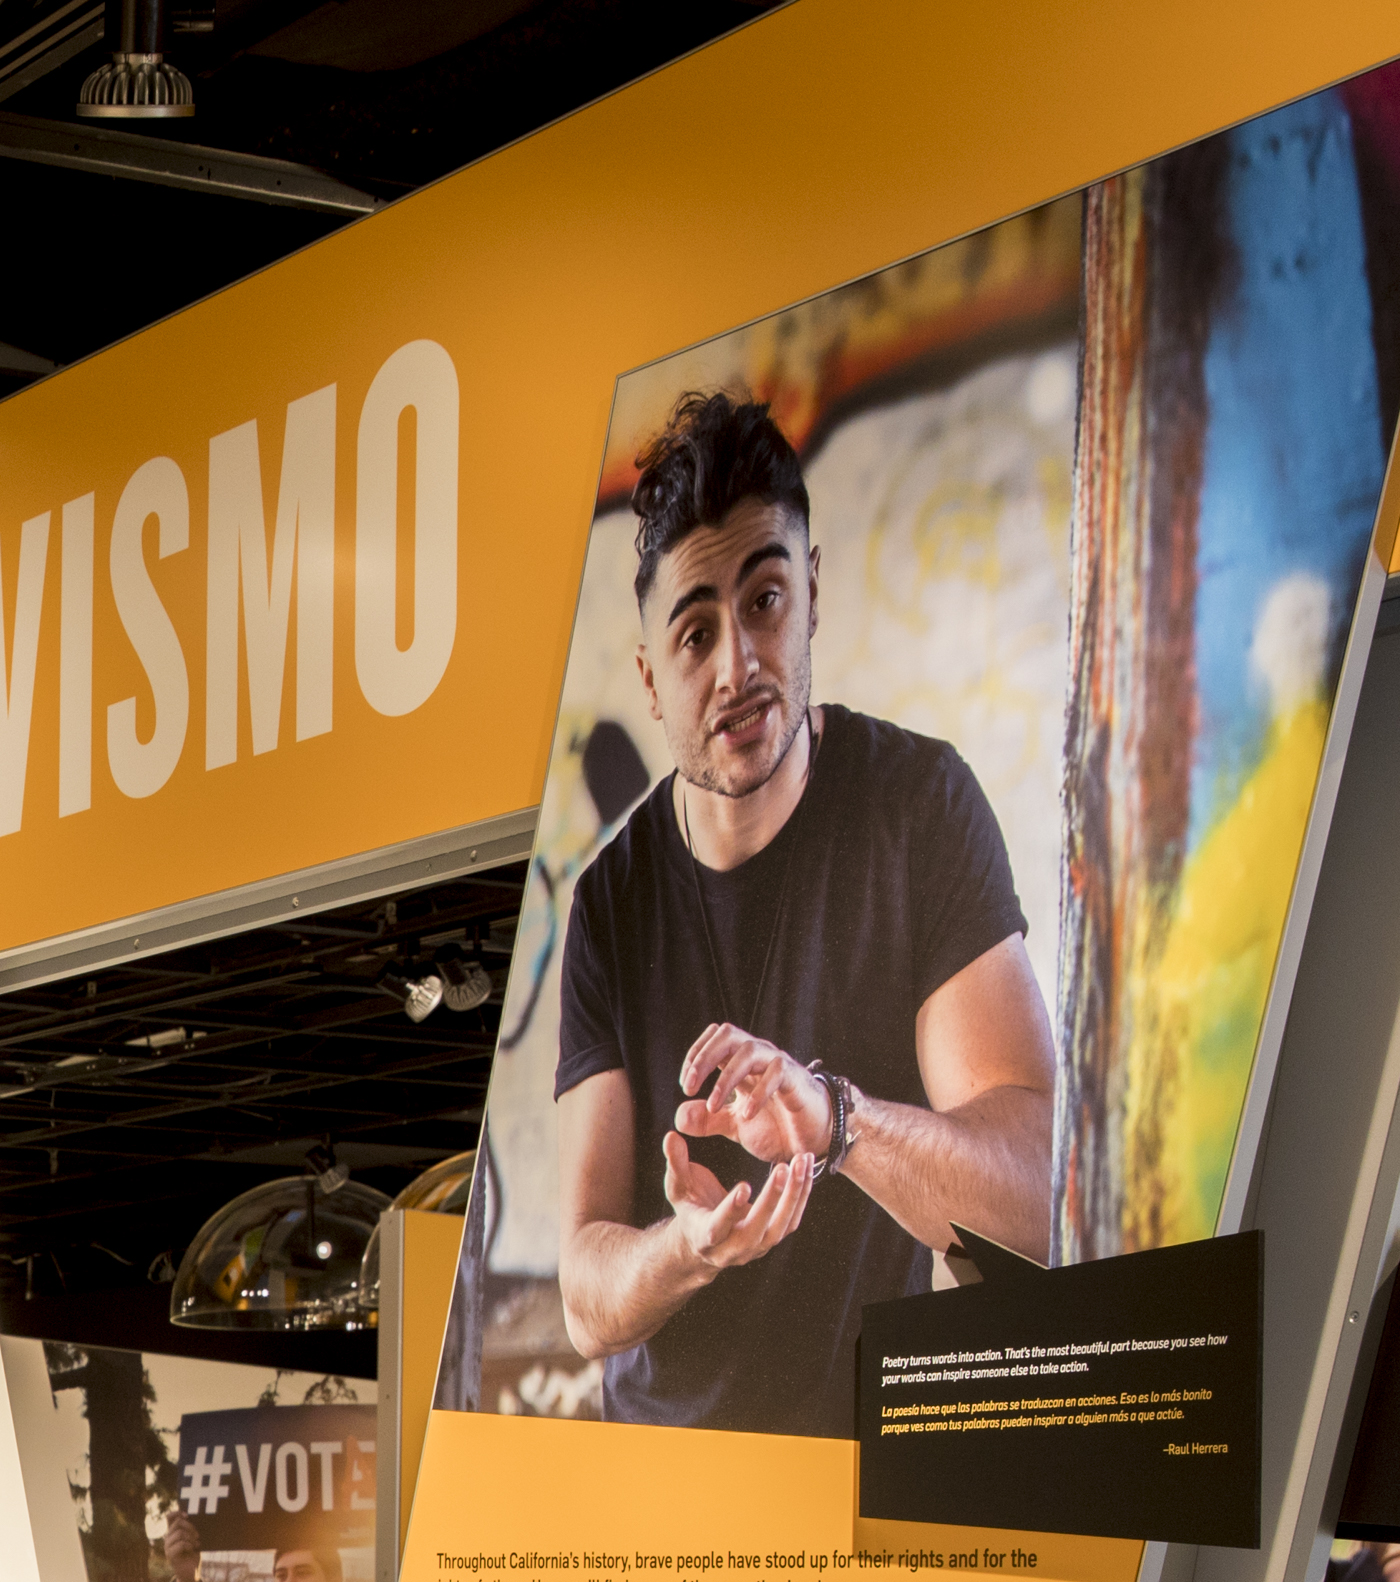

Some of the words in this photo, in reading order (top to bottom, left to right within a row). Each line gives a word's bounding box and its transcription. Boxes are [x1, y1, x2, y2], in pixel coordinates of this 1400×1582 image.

[882, 1356, 909, 1369] Poetry
[910, 1355, 931, 1366] turns
[932, 1352, 957, 1364] words
[958, 1350, 974, 1362] into
[975, 1349, 1003, 1361] action.
[1004, 1347, 1030, 1359] That's
[1031, 1346, 1046, 1357] the
[1047, 1344, 1070, 1356] most
[1070, 1341, 1110, 1355] beautiful
[1110, 1340, 1130, 1355] part
[1131, 1339, 1170, 1351] because
[1170, 1338, 1188, 1351] you
[1189, 1337, 1206, 1347] see
[1207, 1334, 1228, 1345] how
[881, 1374, 900, 1387] your
[901, 1371, 926, 1383] words
[927, 1372, 942, 1382] can
[942, 1369, 971, 1382] inspire
[971, 1368, 1010, 1379] someone
[1010, 1365, 1029, 1376] else
[1029, 1365, 1039, 1375] to
[1040, 1363, 1059, 1374] take
[1060, 1361, 1089, 1373] action.
[1192, 1443, 1228, 1454] Herrera
[436, 1552, 507, 1574] Throughout
[509, 1551, 580, 1570] California's
[583, 1551, 632, 1574] history,
[635, 1551, 673, 1569] brave
[676, 1550, 724, 1574] people
[727, 1550, 762, 1569] have
[764, 1549, 806, 1569] stood
[809, 1554, 829, 1574] up
[832, 1548, 854, 1569] for
[857, 1548, 895, 1569] their
[898, 1548, 945, 1574] rights
[948, 1548, 979, 1569] and
[982, 1547, 1007, 1569] for
[1010, 1547, 1038, 1569] the
